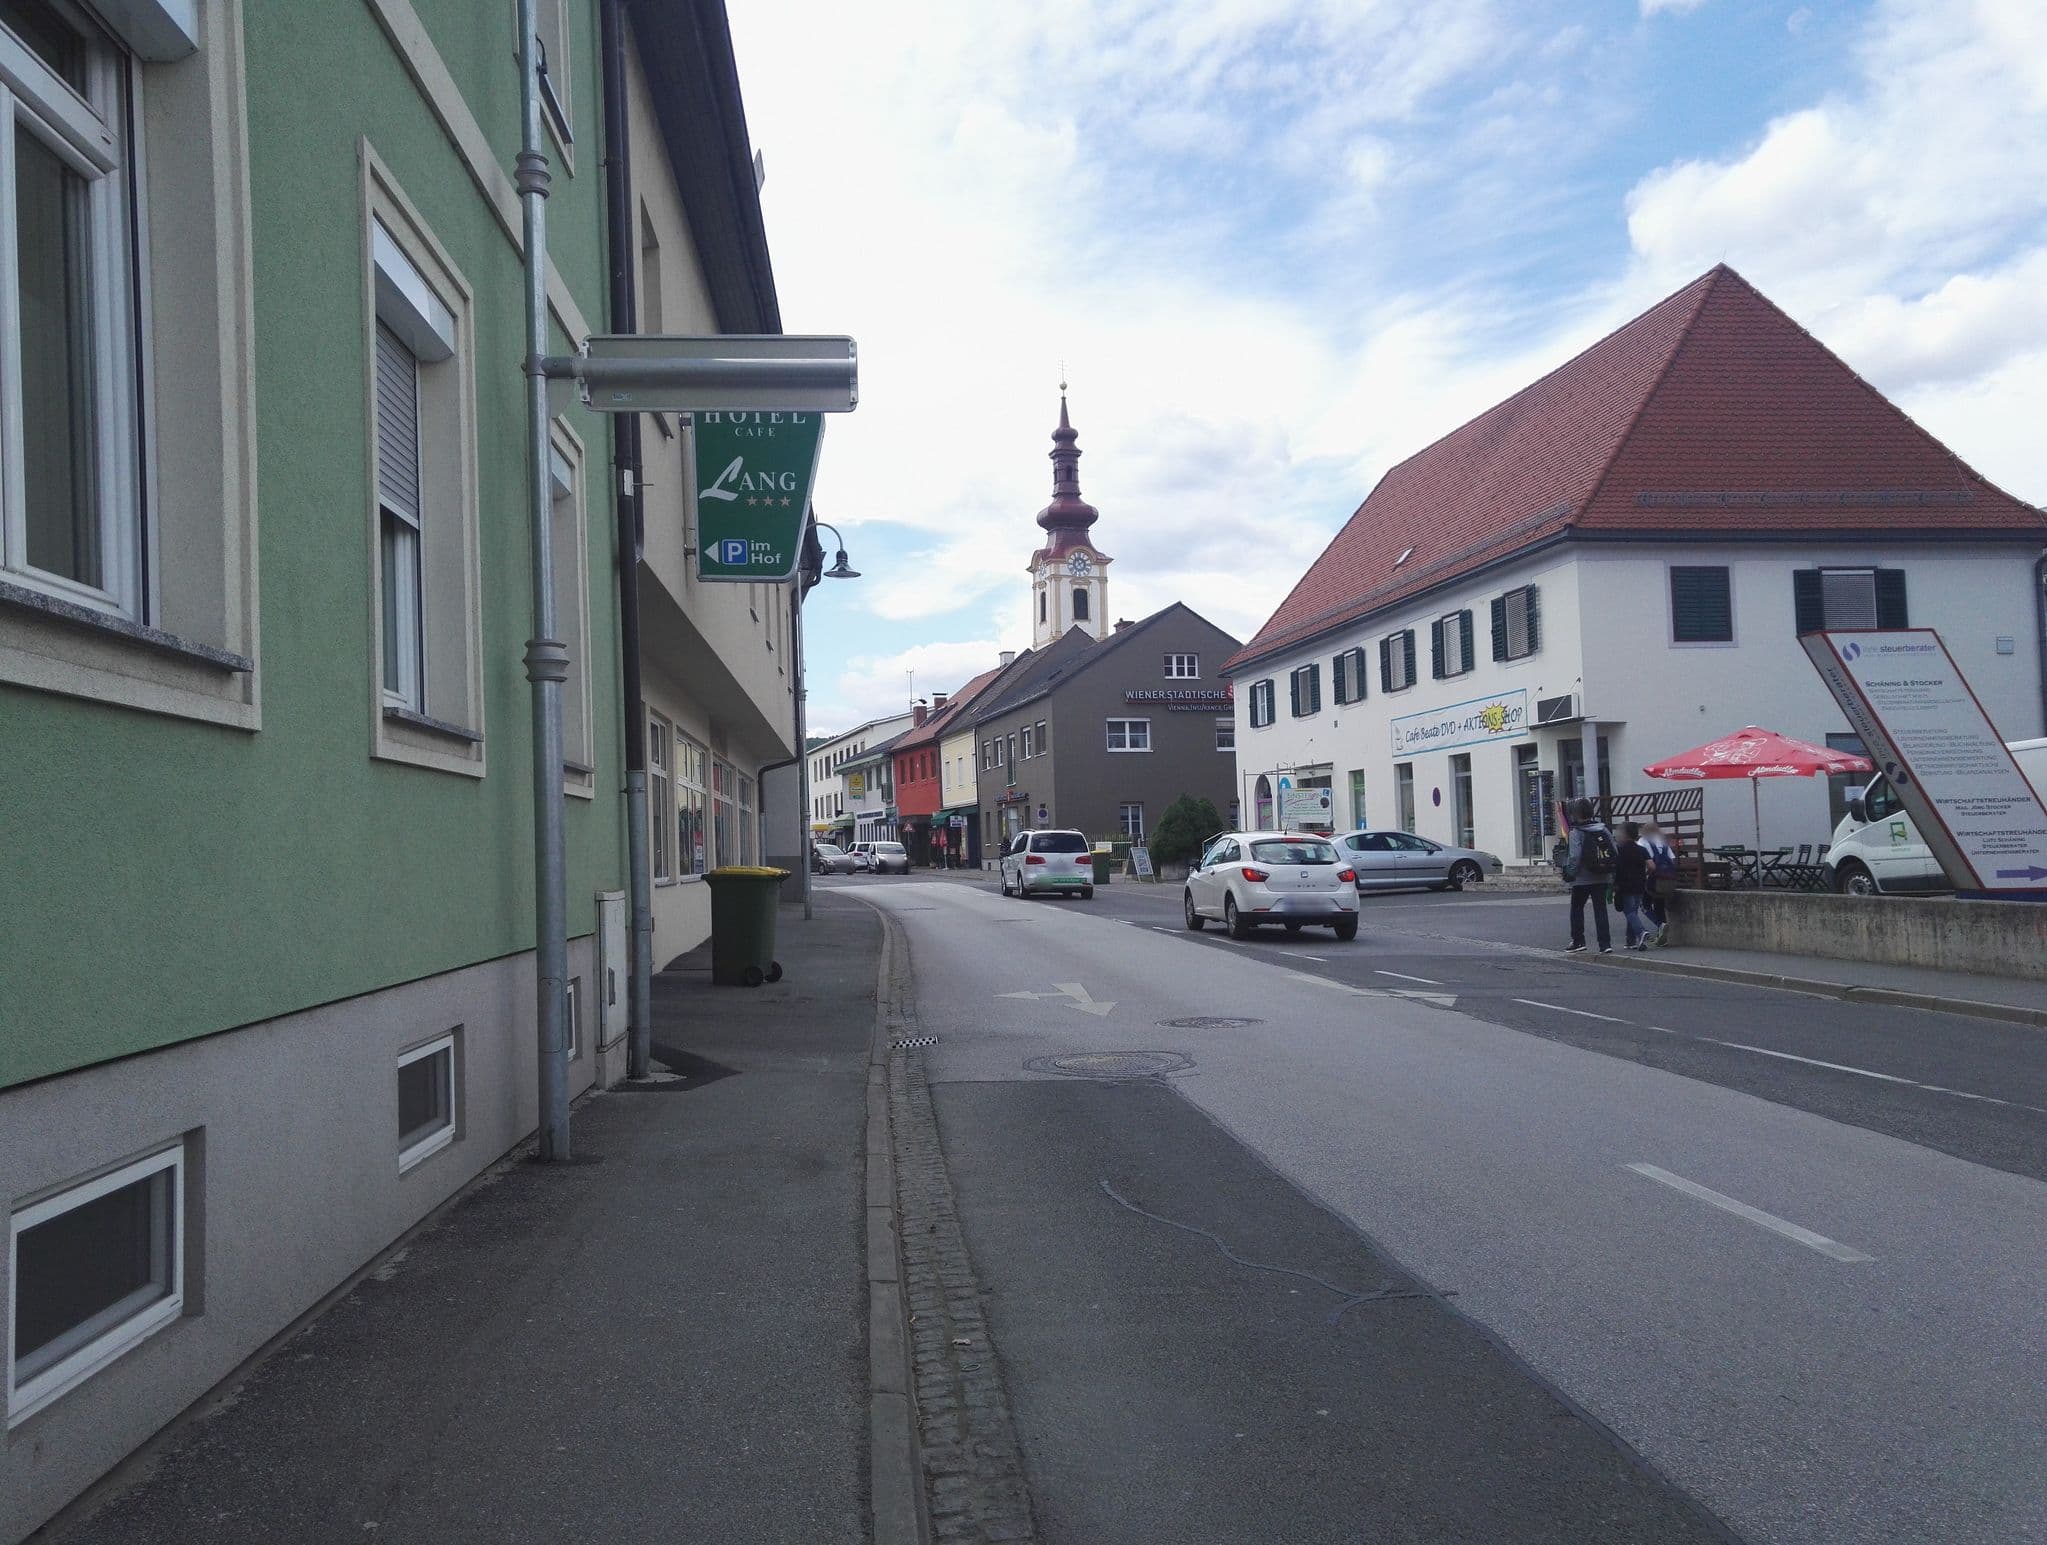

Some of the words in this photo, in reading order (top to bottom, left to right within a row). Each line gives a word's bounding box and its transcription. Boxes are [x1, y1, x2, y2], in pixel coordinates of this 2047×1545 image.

[734, 427, 776, 437] CAFE
[699, 455, 796, 501] LANG
[751, 540, 770, 551] im
[751, 552, 781, 564] Hof
[1880, 644, 1936, 653] steuerberater
[1125, 690, 1165, 699] WIENER
[1441, 721, 1456, 738] DVD
